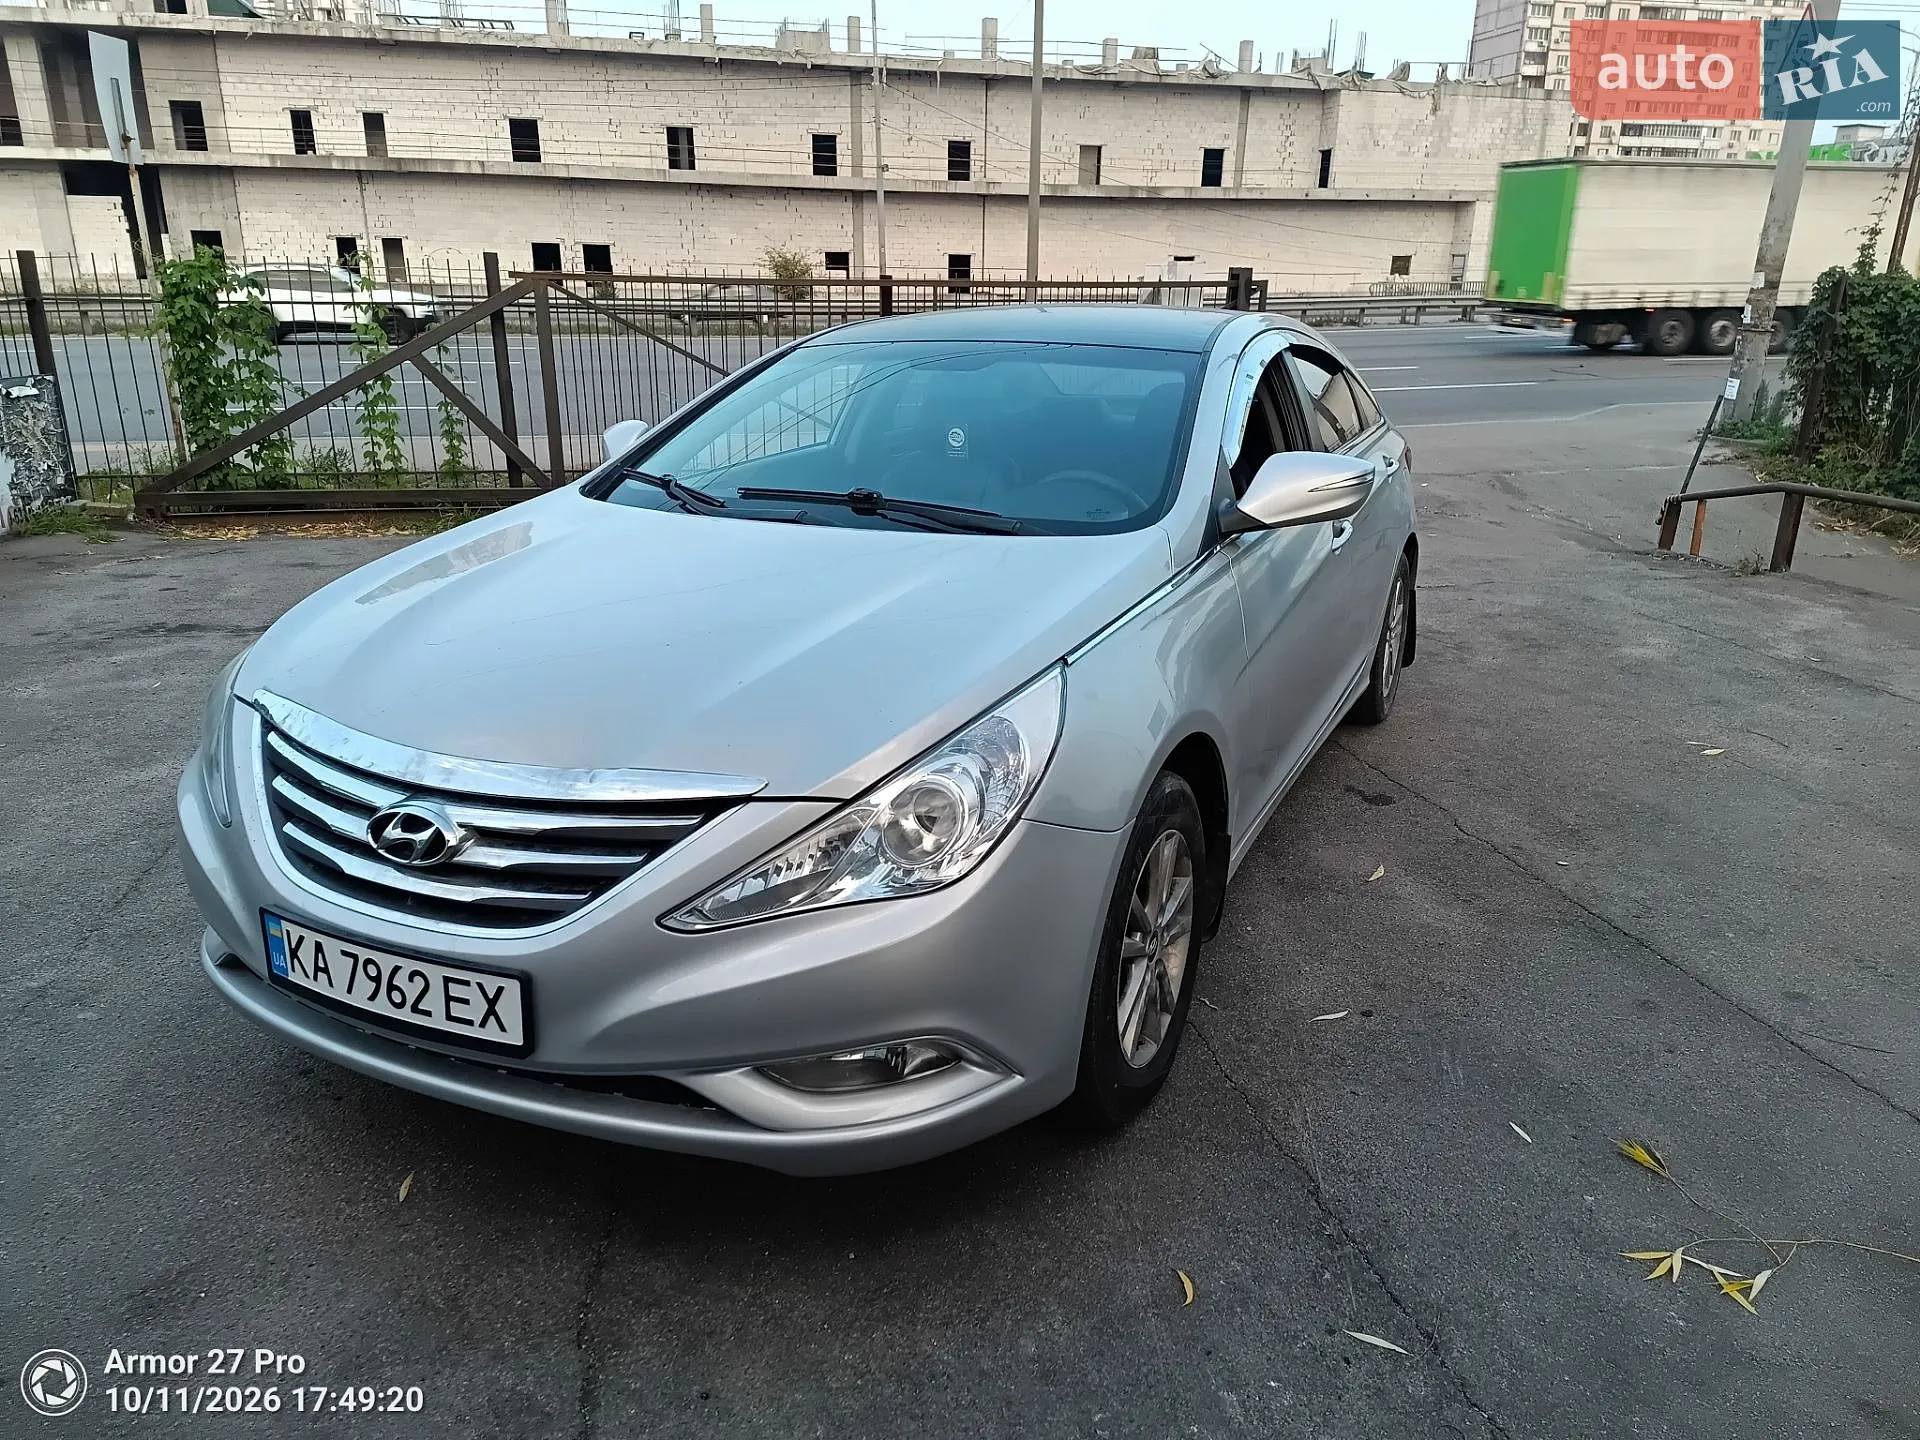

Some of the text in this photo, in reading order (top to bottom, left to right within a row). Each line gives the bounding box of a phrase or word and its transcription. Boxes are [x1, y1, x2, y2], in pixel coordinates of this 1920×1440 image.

[272, 951, 287, 969] UA
[285, 928, 508, 1034] KA 7962 EX
